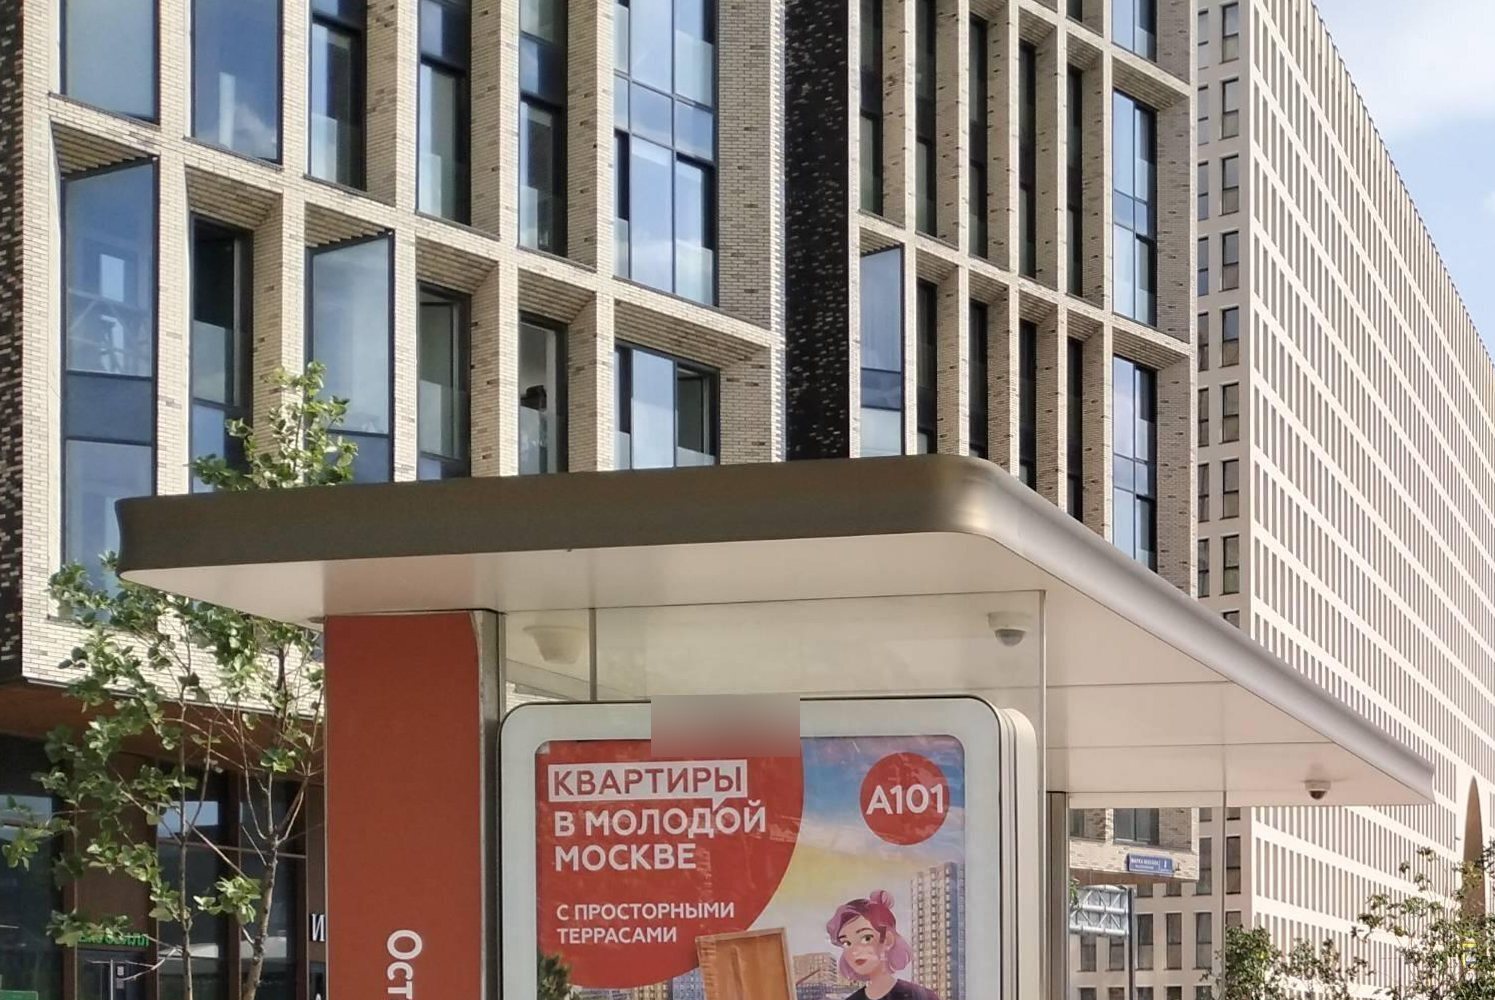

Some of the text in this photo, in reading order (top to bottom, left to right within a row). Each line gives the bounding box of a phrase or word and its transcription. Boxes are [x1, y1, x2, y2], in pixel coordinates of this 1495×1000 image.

[553, 765, 743, 798] КВАРТИРЫ
[866, 784, 945, 816] А101
[554, 800, 767, 840] В МОЛОДОЙ
[555, 843, 697, 872] МОСКВЕ
[557, 902, 735, 922] С ПРОСТОРНЫМИ
[557, 926, 678, 945] ТЕРРАСАМИ
